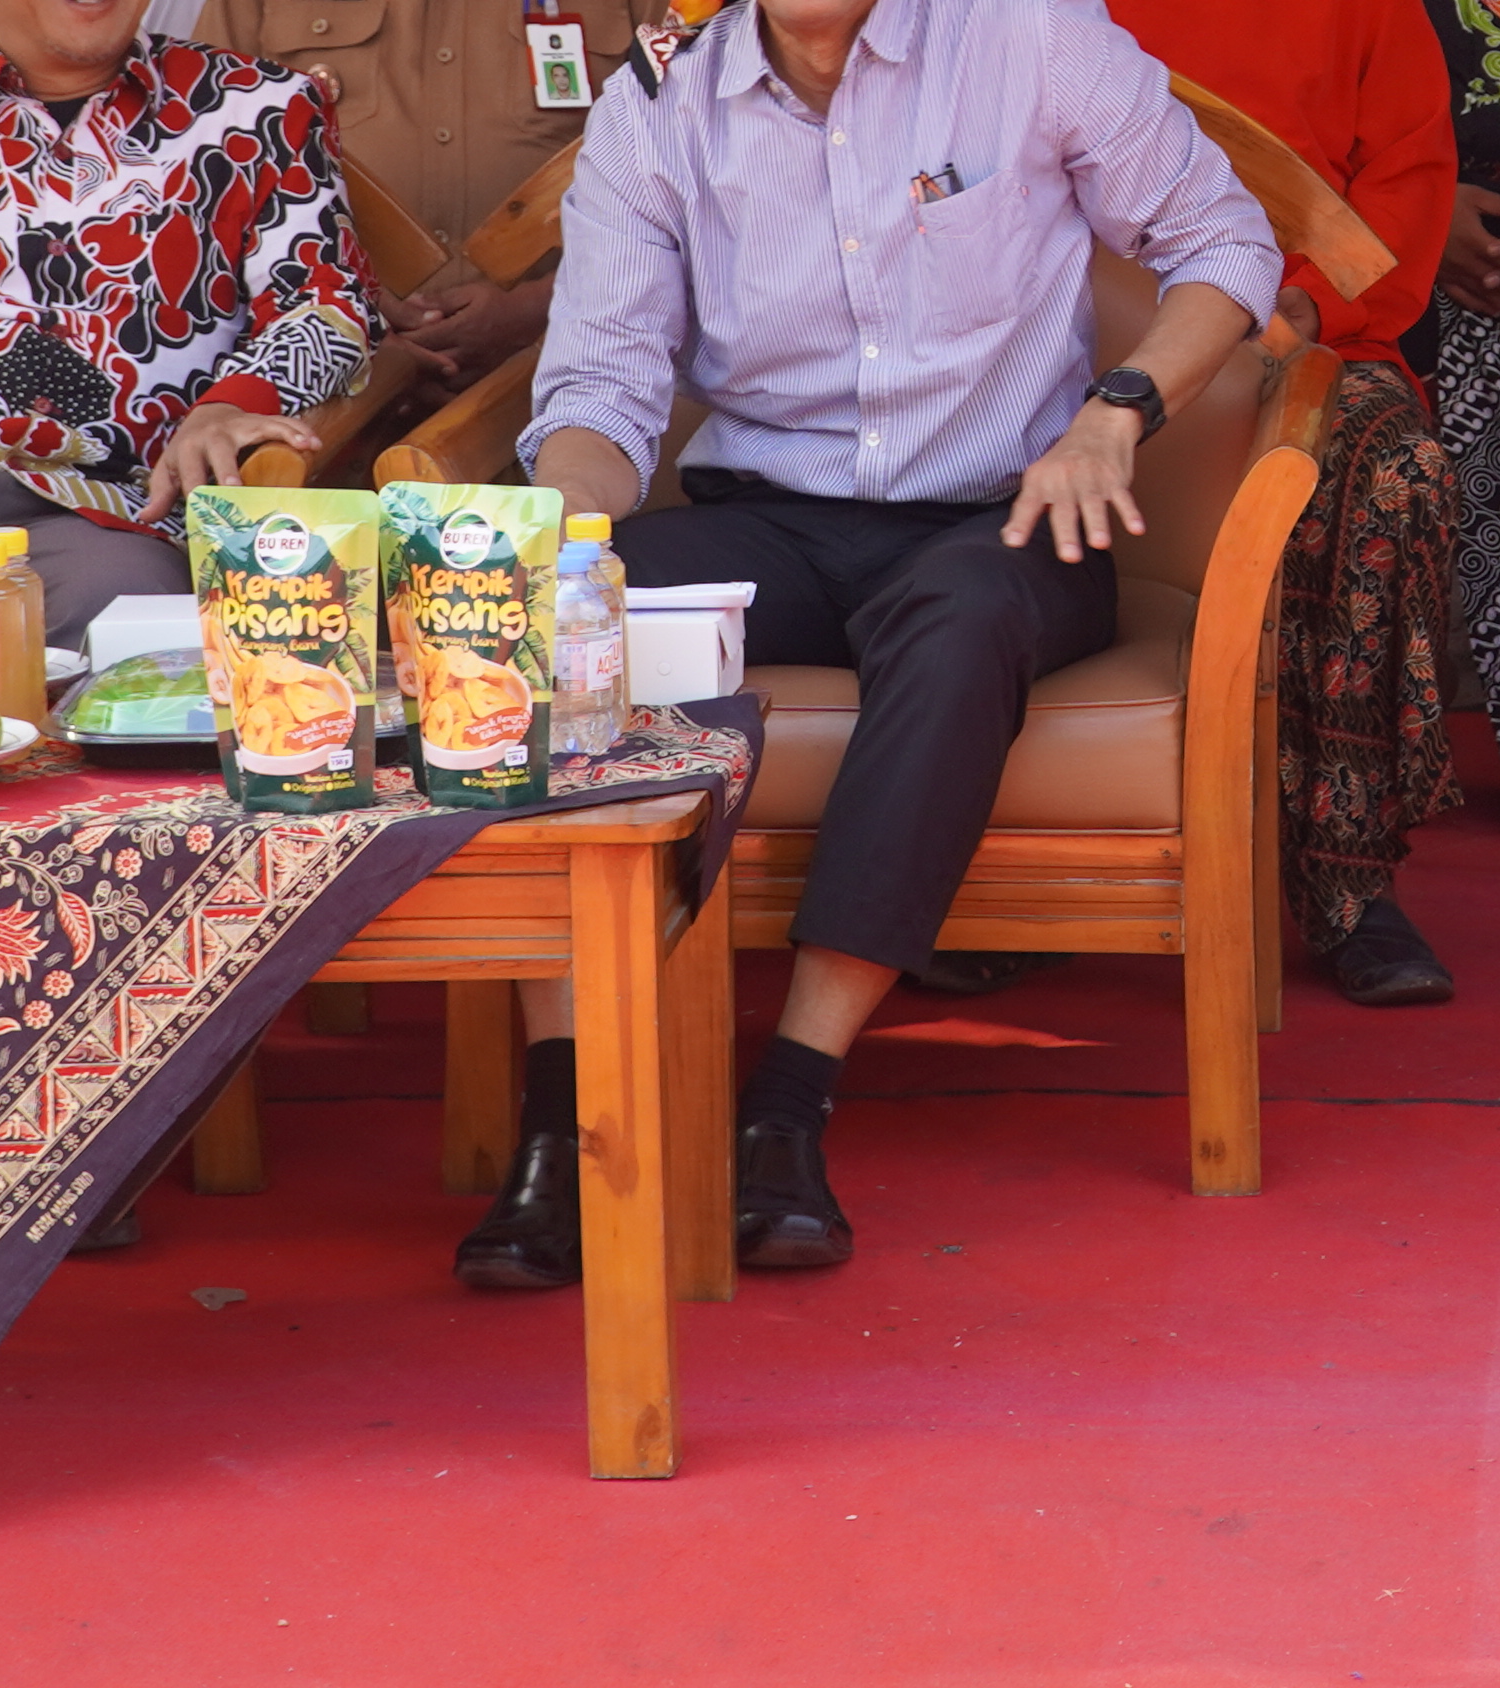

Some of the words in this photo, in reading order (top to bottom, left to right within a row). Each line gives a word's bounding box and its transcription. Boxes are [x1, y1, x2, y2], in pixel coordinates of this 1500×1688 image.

[225, 569, 333, 604] Keripik
[410, 563, 514, 599] Keripik
[221, 596, 349, 643] Pisang
[411, 590, 528, 641] Pisang
